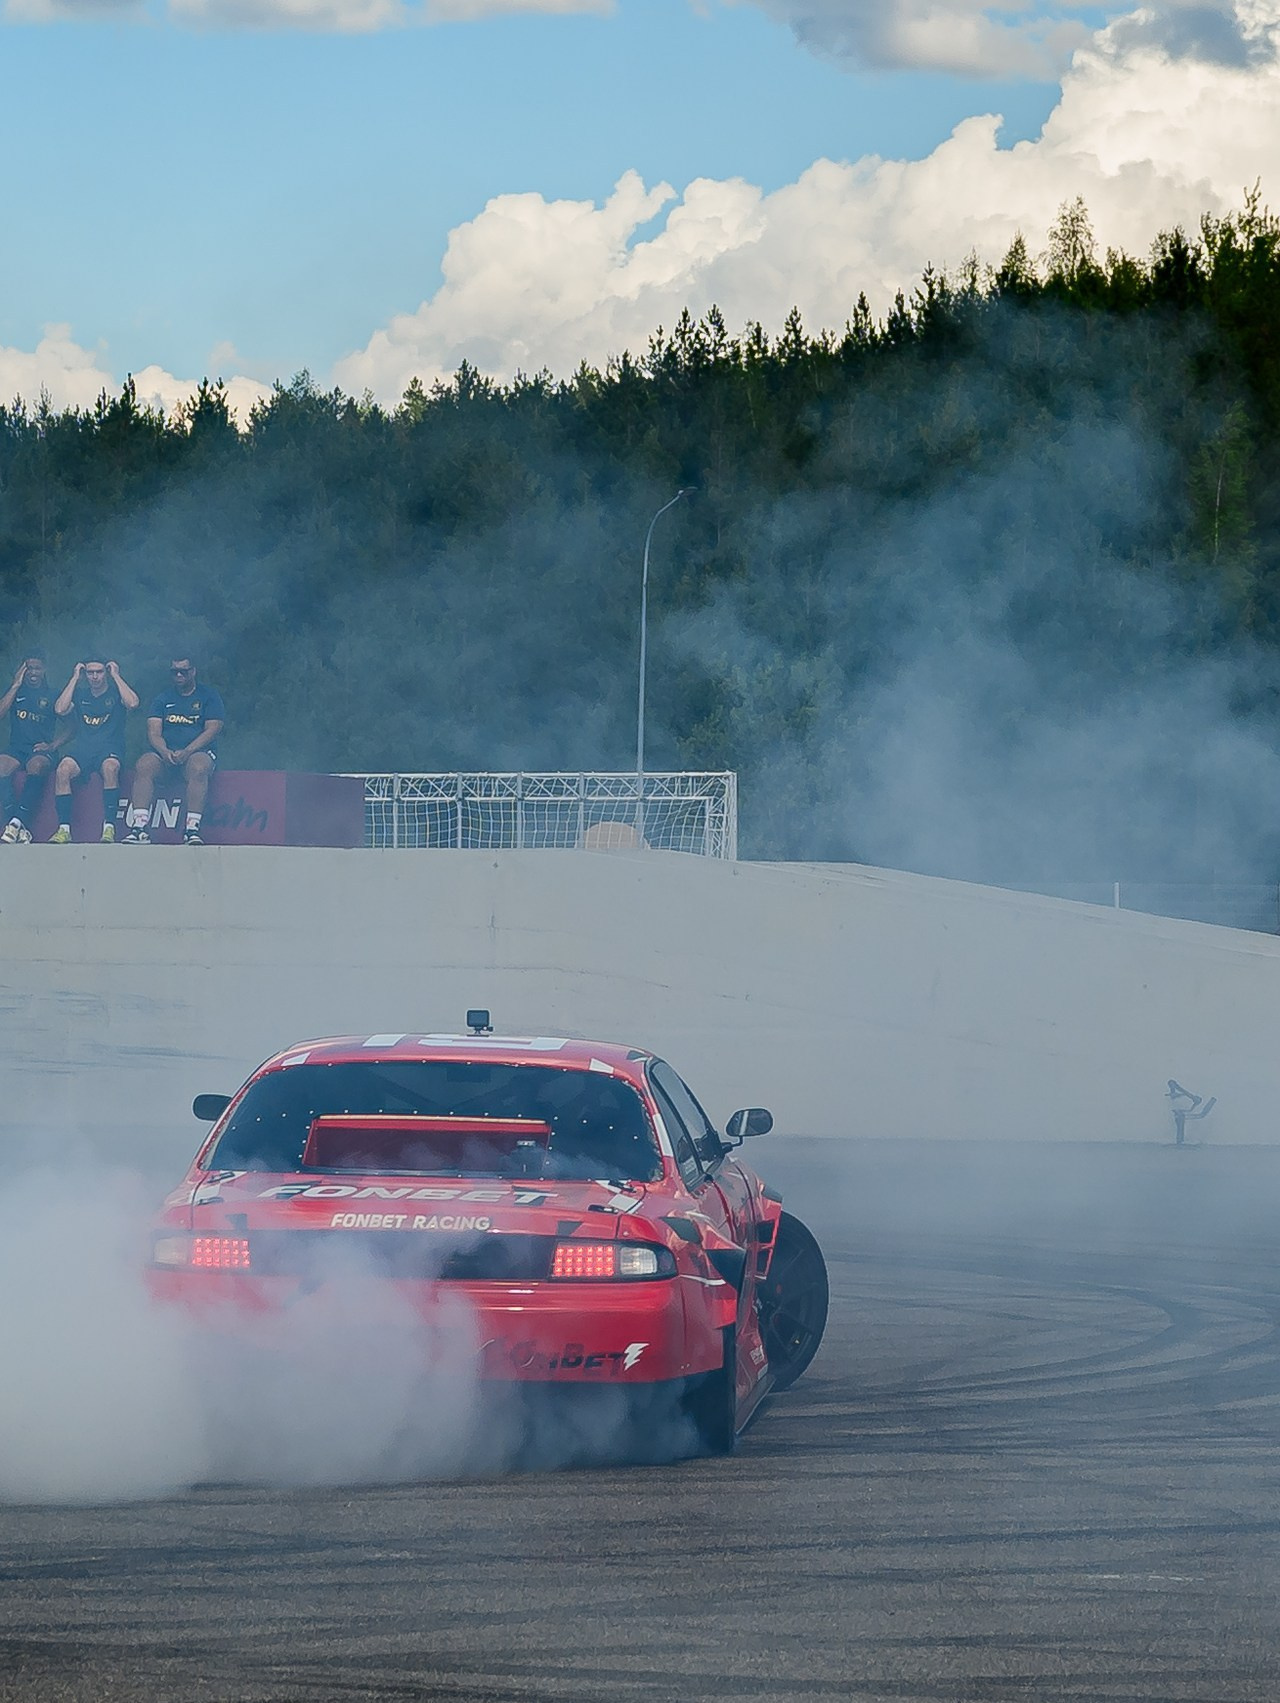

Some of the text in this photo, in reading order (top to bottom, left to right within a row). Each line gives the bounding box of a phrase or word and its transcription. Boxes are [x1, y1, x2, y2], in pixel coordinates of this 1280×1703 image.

[257, 1183, 558, 1204] FONBET
[330, 1212, 490, 1231] FONBET RACING
